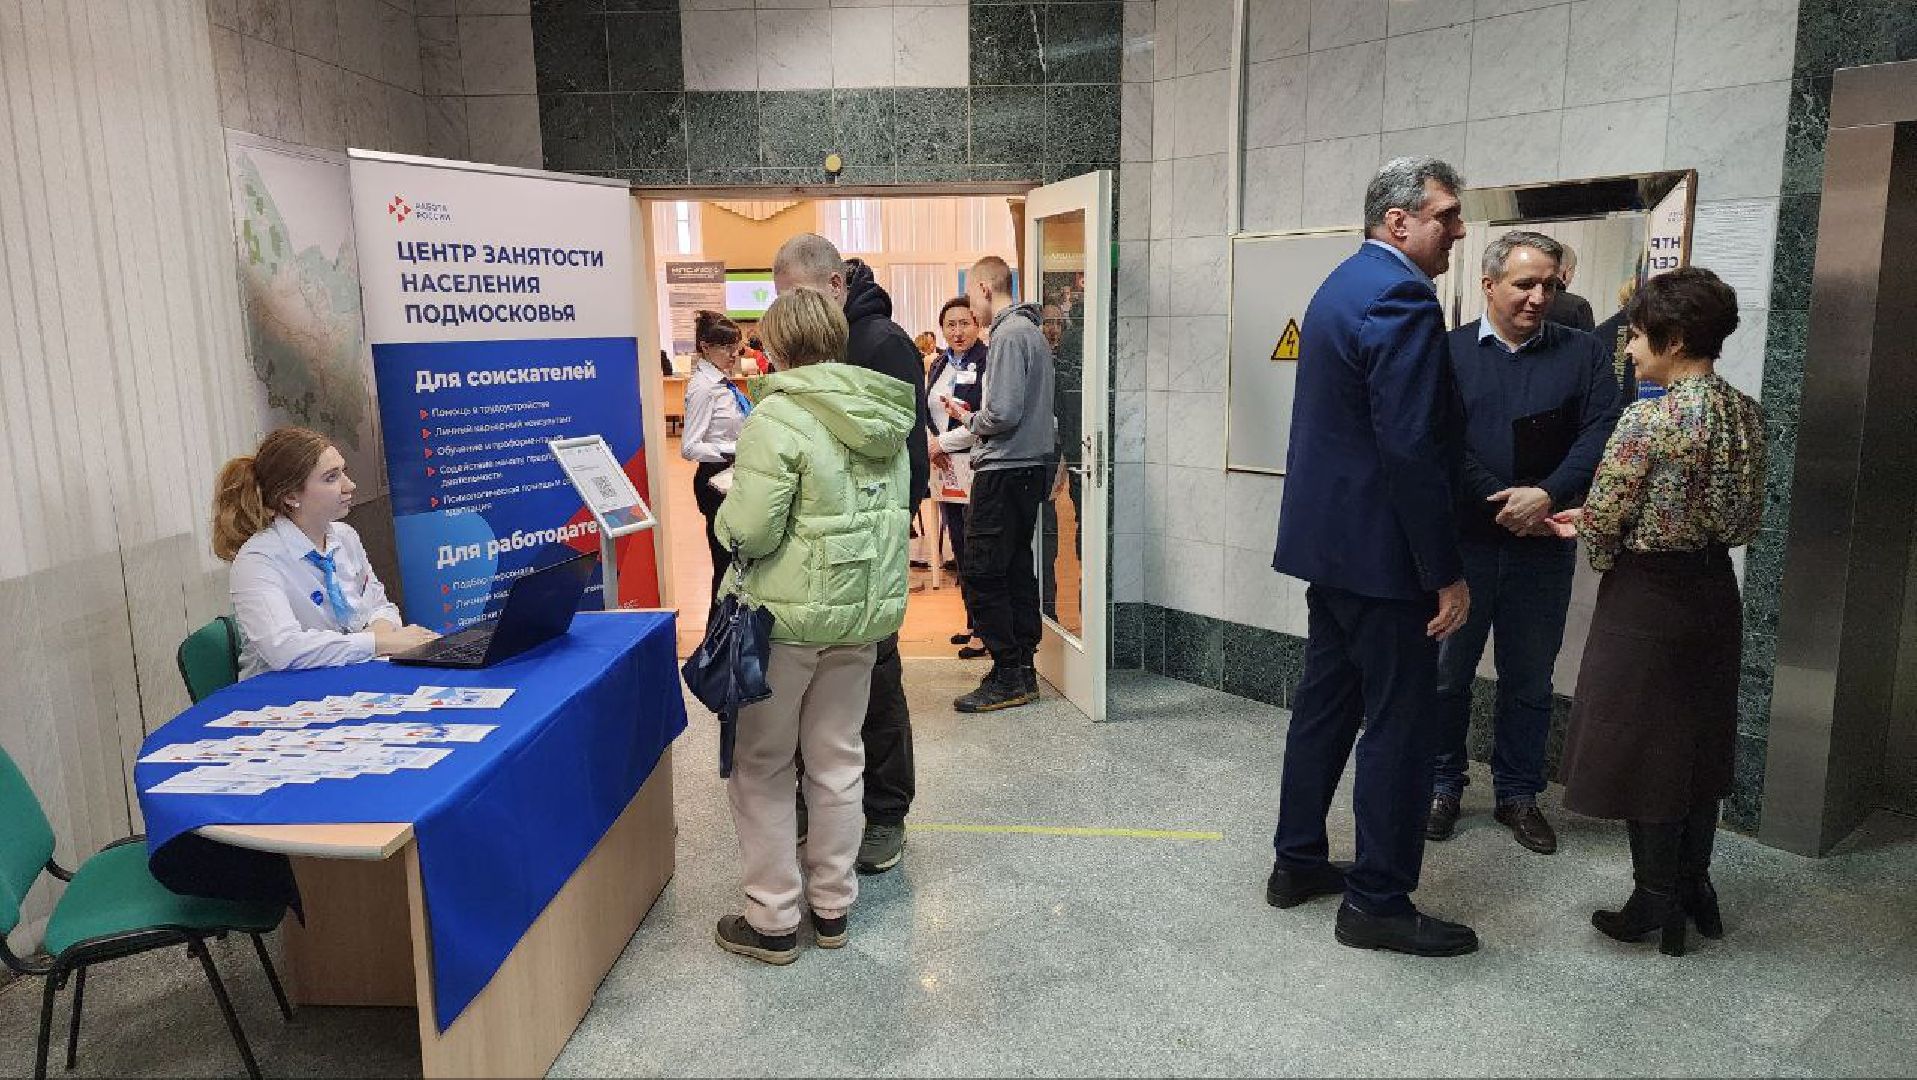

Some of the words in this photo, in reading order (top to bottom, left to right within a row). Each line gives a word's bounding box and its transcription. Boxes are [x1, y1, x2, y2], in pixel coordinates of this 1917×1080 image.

[397, 241, 477, 264] ЦЕНТР
[483, 245, 604, 267] ЗАНЯТОСТИ
[401, 273, 540, 294] НАСЕЛЕНИЯ
[404, 304, 576, 326] ПОДМОСКОВЬЯ
[415, 370, 462, 393] Для
[467, 360, 597, 387] соискателей
[431, 407, 471, 417] Помощь
[435, 424, 473, 436] Личный
[474, 420, 522, 432] карьерный
[524, 415, 572, 427] консультант
[437, 443, 483, 456] Обучение
[440, 461, 493, 474] Содействие
[440, 472, 503, 488] деятельности
[443, 486, 519, 504] Психологическая
[437, 543, 480, 569] Для
[487, 519, 600, 561] работодате
[453, 577, 488, 590] Подбор
